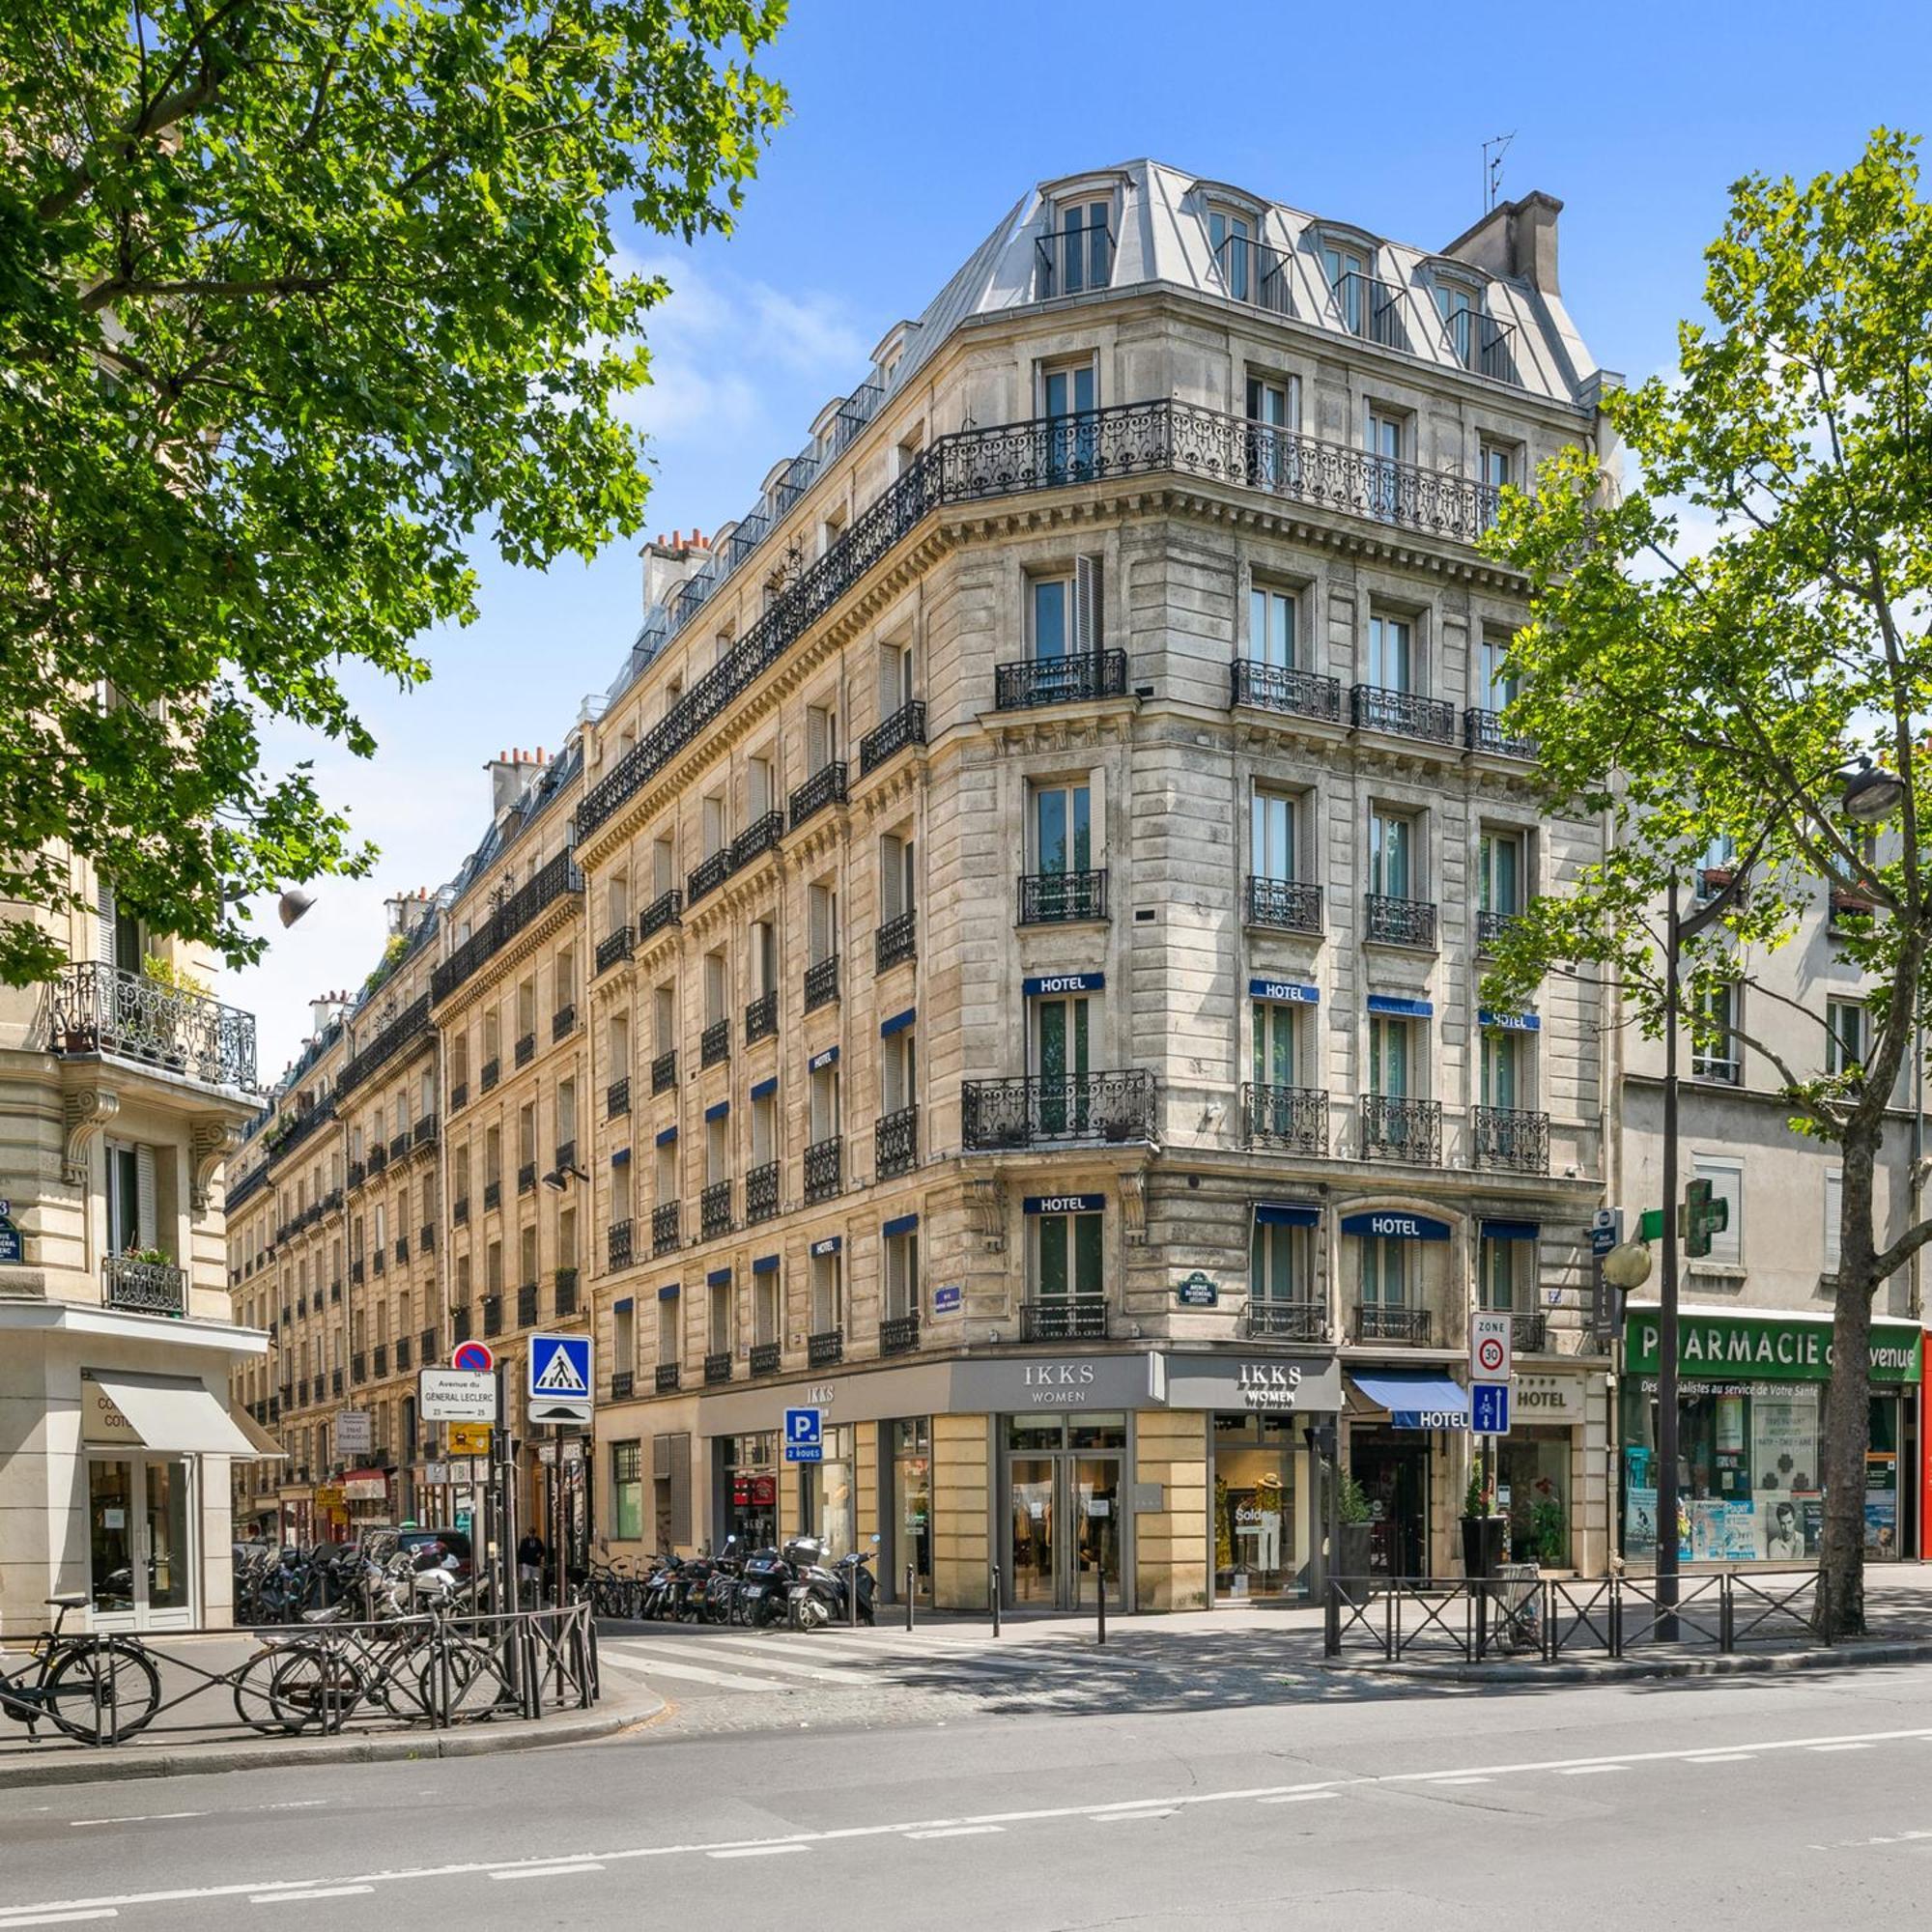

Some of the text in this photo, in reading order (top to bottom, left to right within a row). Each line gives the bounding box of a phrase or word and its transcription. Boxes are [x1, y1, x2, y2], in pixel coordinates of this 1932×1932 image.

[1040, 977, 1086, 992] HOTEL
[1265, 983, 1305, 1001] HOTEL
[1040, 1197, 1086, 1211] HOTEL
[1372, 1217, 1420, 1236] HOTEL
[1478, 1321, 1505, 1332] ZONE
[1642, 1325, 1819, 1365] PARMACIE
[1485, 1349, 1498, 1360] 30
[1024, 1364, 1094, 1385] IKKS
[1239, 1364, 1302, 1385] IKKS
[807, 1385, 835, 1404] IKKS
[1641, 1379, 1659, 1392] Des
[1711, 1383, 1723, 1394] au
[1724, 1382, 1755, 1396] service
[1756, 1382, 1768, 1396] de
[1769, 1384, 1792, 1397] Votre
[460, 1392, 494, 1402] LECLERC
[1032, 1391, 1086, 1403] WOMEN
[1247, 1391, 1295, 1403] WOMEN
[1515, 1392, 1567, 1407] HOTEL
[1420, 1411, 1469, 1427] HOTEL
[795, 1416, 811, 1438] P
[796, 1449, 820, 1459] ROUES
